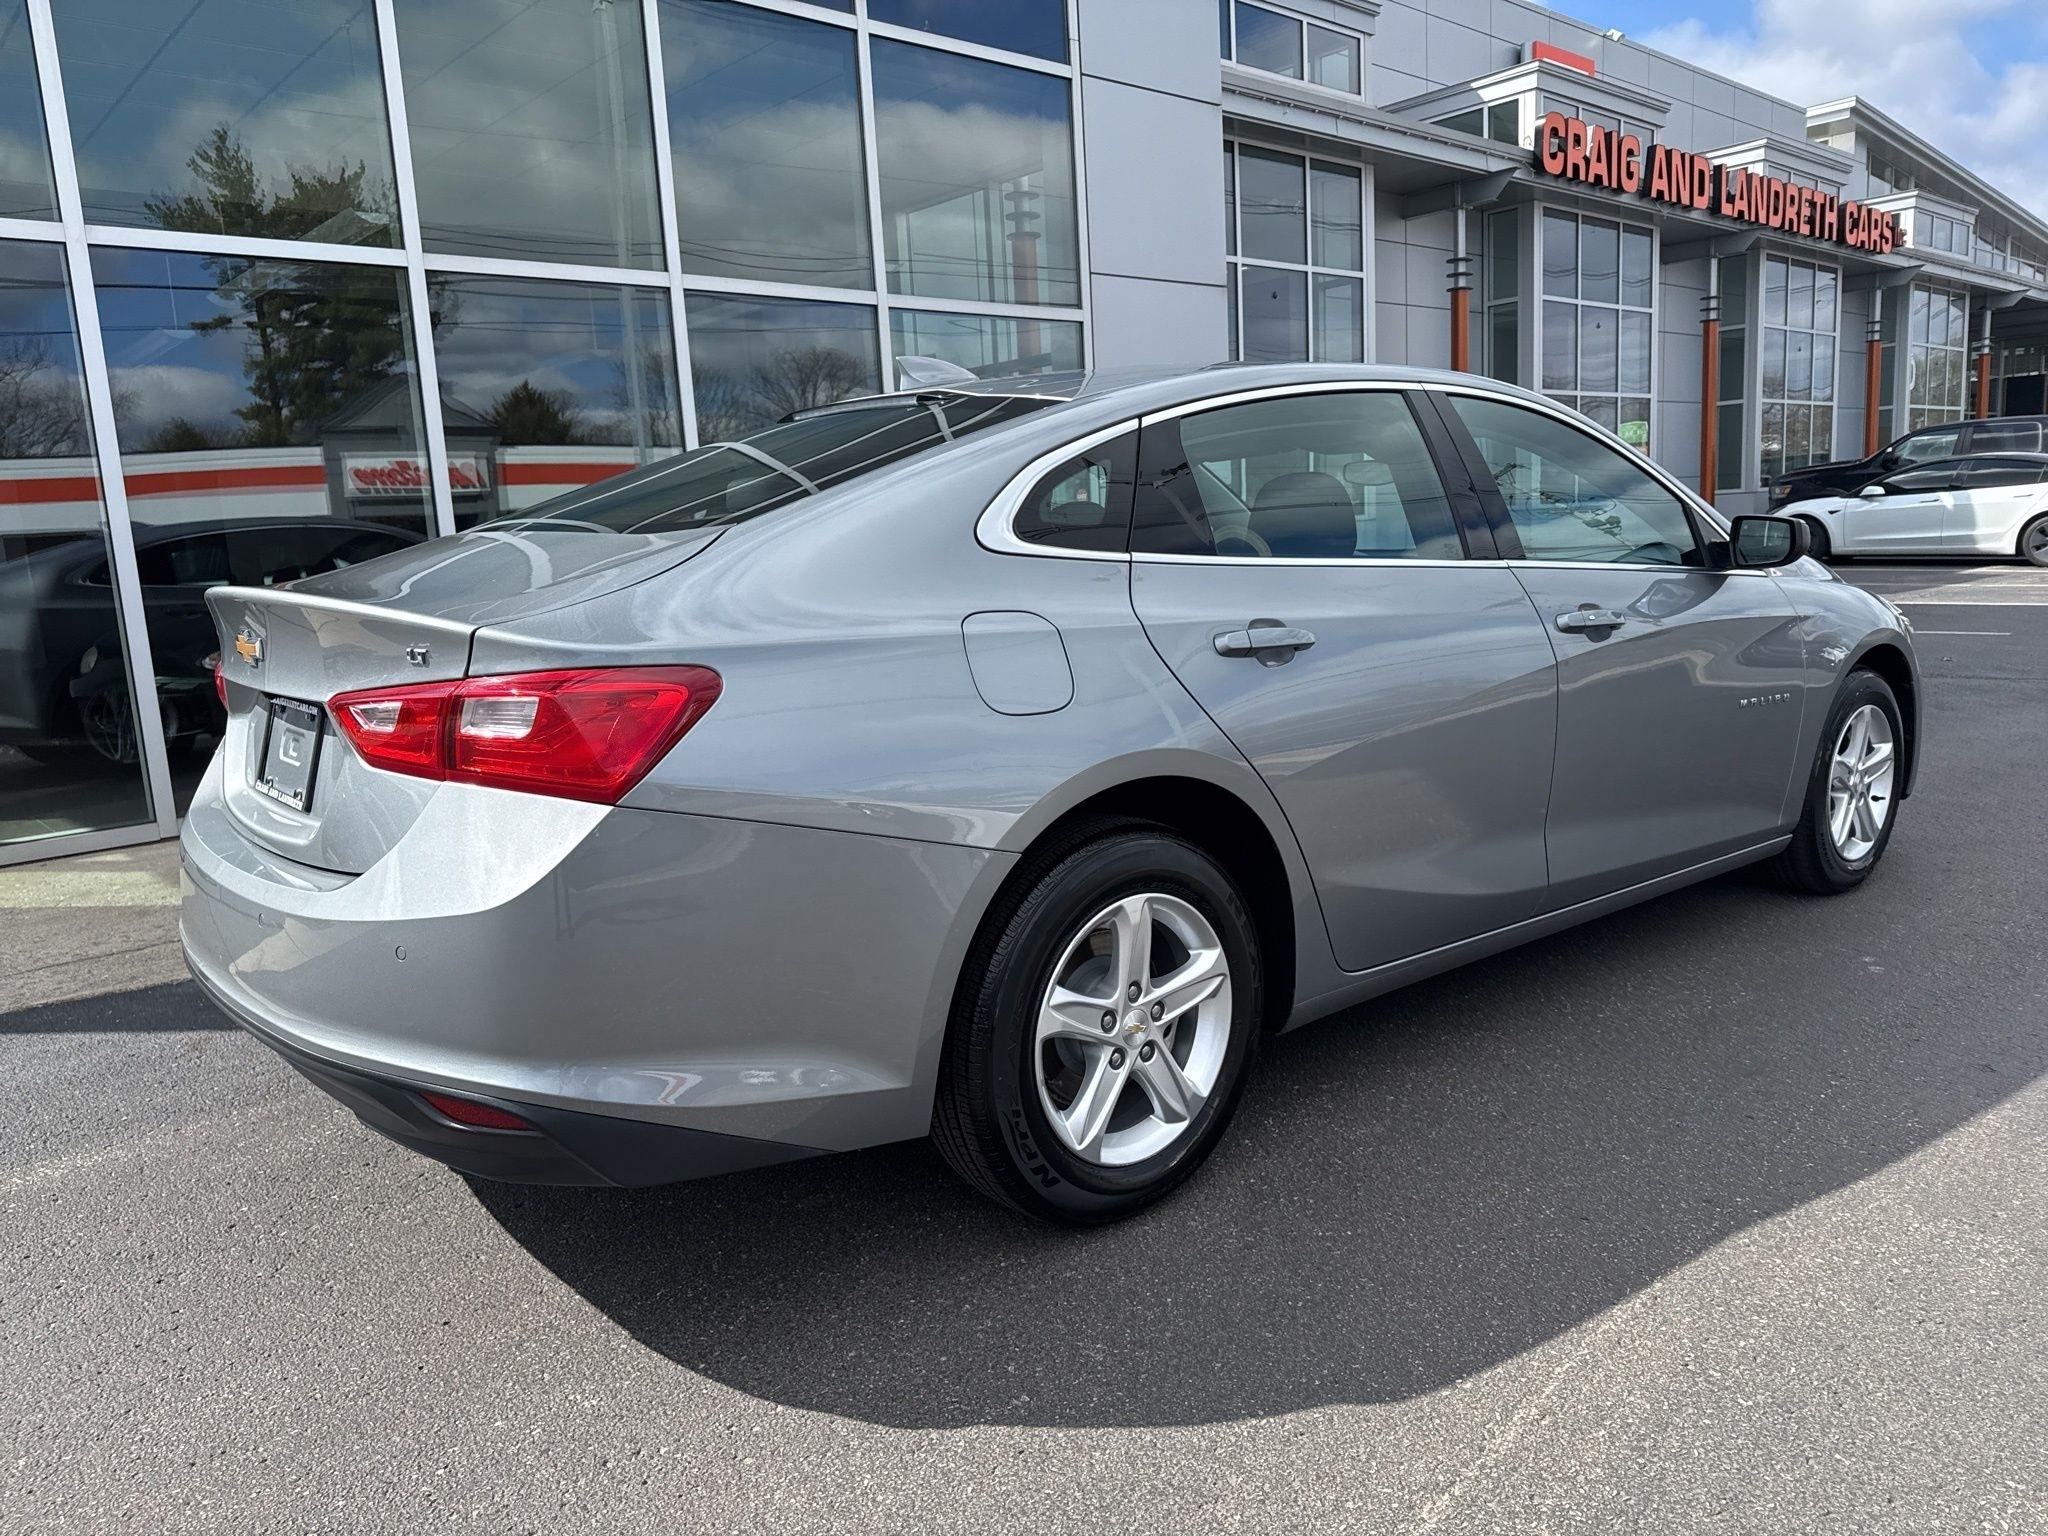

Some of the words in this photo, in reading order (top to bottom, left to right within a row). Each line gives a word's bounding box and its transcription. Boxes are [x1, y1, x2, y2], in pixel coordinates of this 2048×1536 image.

[1542, 111, 1641, 193] CRAIG
[1651, 144, 1709, 210] AND
[1722, 164, 1838, 241] LANDRETH
[1845, 200, 1893, 254] CARS
